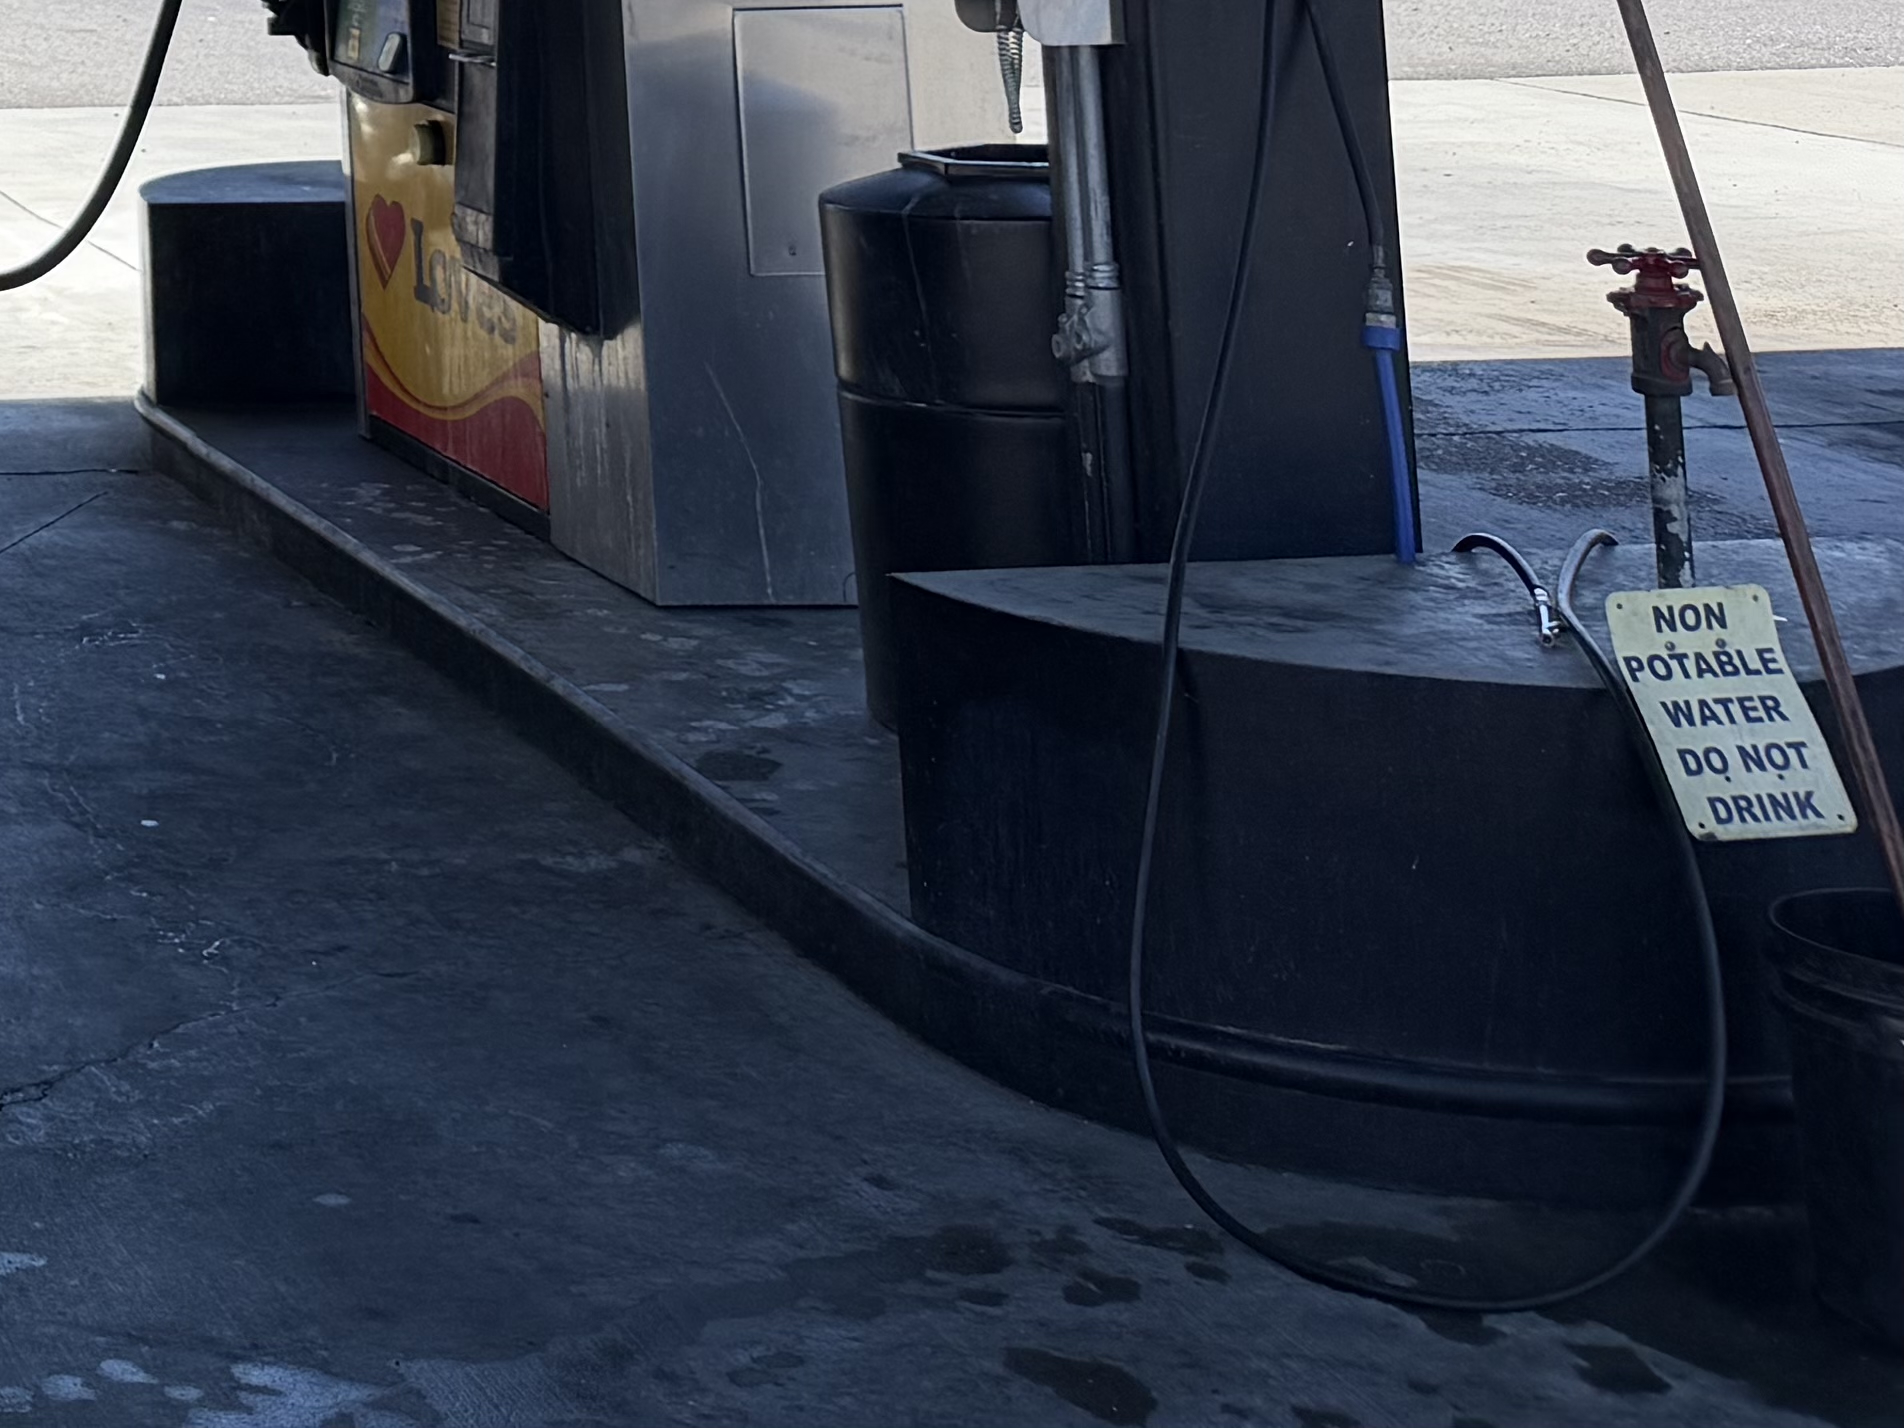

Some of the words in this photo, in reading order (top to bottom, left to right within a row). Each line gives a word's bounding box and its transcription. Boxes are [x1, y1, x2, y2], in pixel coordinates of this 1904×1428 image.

[1652, 601, 1729, 633] NON
[1623, 647, 1785, 683] POTABLE
[1659, 695, 1790, 729] WATER
[1676, 745, 1730, 777] DO
[1736, 741, 1809, 774] NOT
[1707, 790, 1826, 825] DRINK
